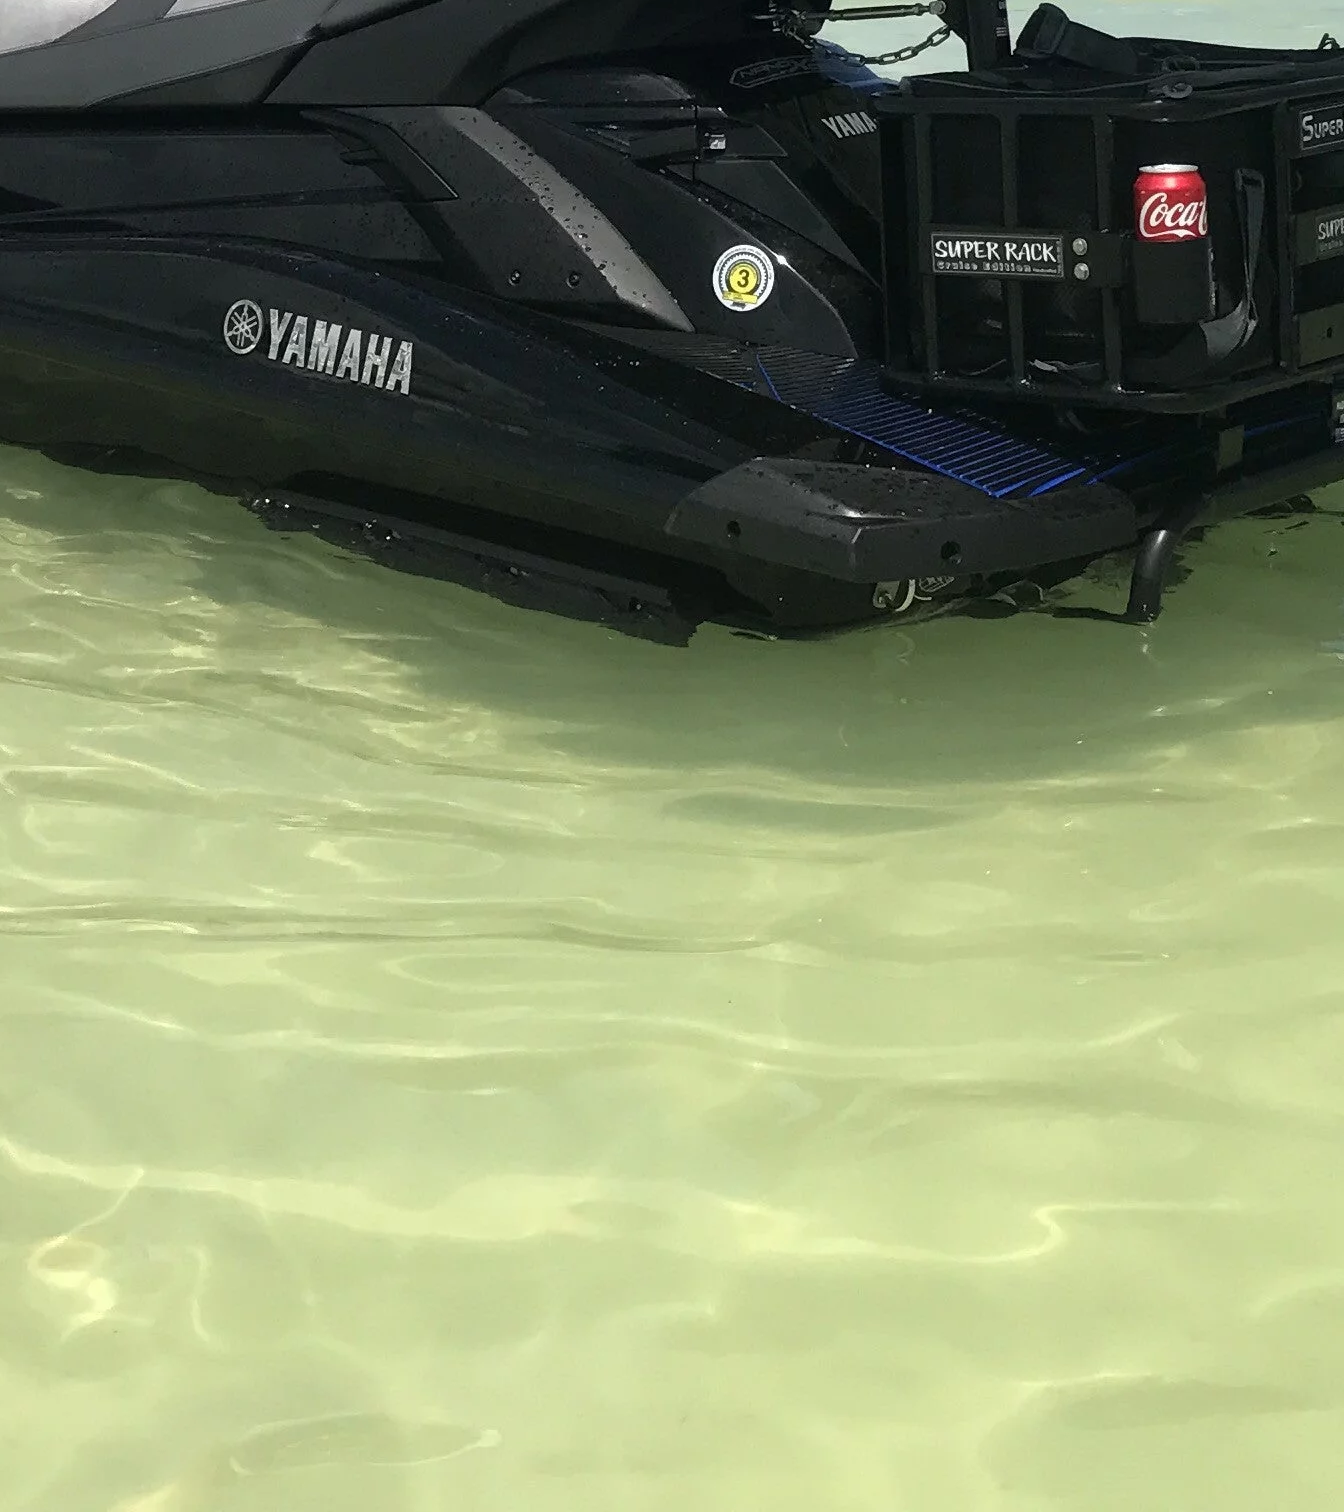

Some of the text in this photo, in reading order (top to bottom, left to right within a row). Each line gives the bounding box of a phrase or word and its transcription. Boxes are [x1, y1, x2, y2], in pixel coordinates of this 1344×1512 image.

[820, 111, 877, 139] YAMA
[934, 240, 1001, 261] SUPER
[1004, 241, 1057, 263] RACK
[736, 268, 750, 288] 3
[267, 308, 414, 396] YAMAHA
